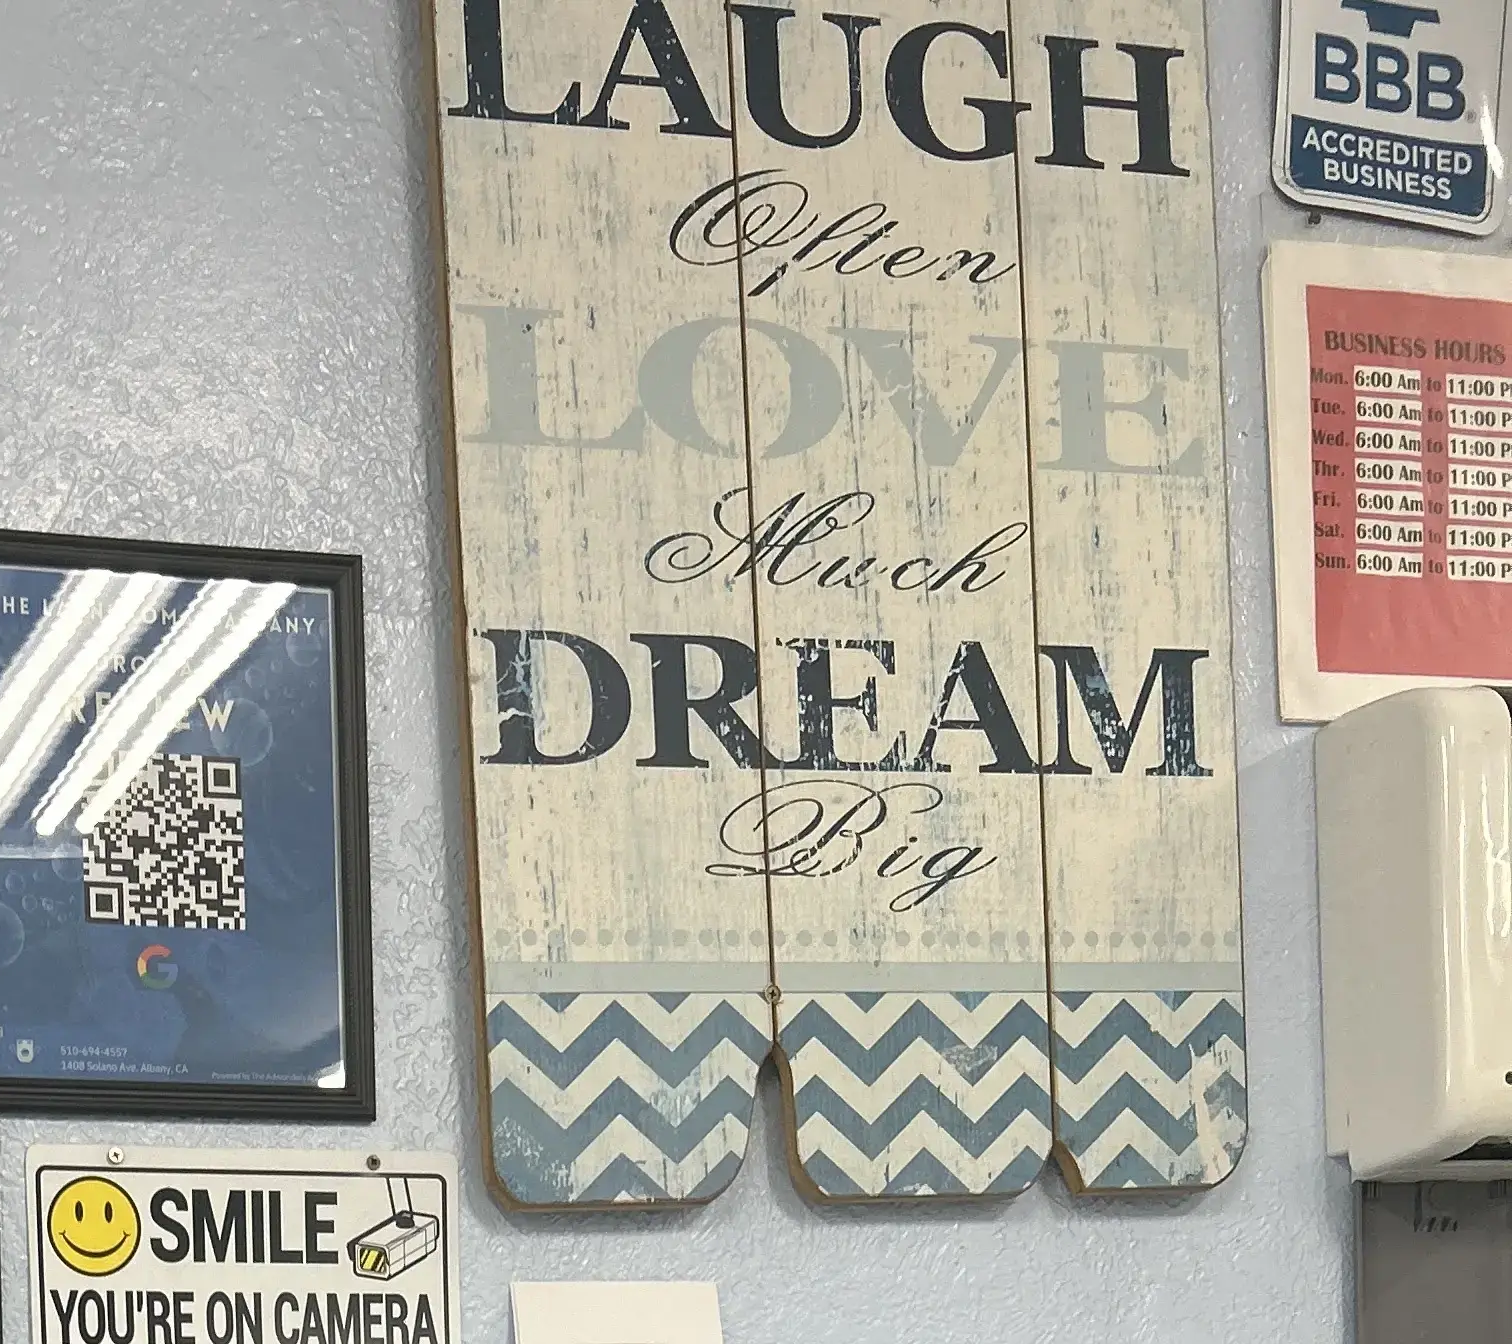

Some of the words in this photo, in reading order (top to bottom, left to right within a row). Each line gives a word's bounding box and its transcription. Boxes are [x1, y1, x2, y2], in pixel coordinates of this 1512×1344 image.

[447, 0, 1193, 178] LAUGH
[1314, 32, 1466, 121] BBB
[1302, 127, 1473, 176] ACCREDITED
[1323, 158, 1452, 200] BUSINESS
[669, 168, 1018, 297] Often
[1325, 330, 1426, 358] BUSINESS
[1435, 339, 1506, 365] HOURS
[455, 302, 1209, 479] LOVE
[1310, 367, 1348, 385] Mon.
[1355, 370, 1393, 388] 6:00
[1398, 374, 1420, 390] Am
[1427, 377, 1441, 391] to
[1448, 378, 1494, 396] 11:00
[1312, 398, 1345, 415] Tue.
[1357, 401, 1393, 419] 6:00
[1399, 405, 1421, 421] Am
[1428, 408, 1443, 422] to
[1450, 409, 1495, 427] 11:00
[1312, 429, 1349, 446] Wed.
[1356, 431, 1393, 449] 6:00
[1399, 435, 1421, 451] Am
[1427, 439, 1443, 452] to
[1450, 438, 1495, 456] 11:00
[1313, 460, 1344, 477] Thr.
[1356, 462, 1393, 480] 6:00
[1399, 465, 1422, 481] Am
[1427, 469, 1443, 484] to
[1451, 469, 1496, 486] 11:00
[1314, 491, 1341, 507] Fri.
[1357, 493, 1394, 511] 6:00
[1399, 496, 1423, 512] Am
[1428, 501, 1443, 514] to
[1451, 499, 1497, 517] 11:00
[644, 487, 1028, 593] Much
[1314, 522, 1344, 538] Sat.
[1357, 523, 1392, 541] 6:00
[1397, 527, 1422, 543] Am
[1428, 530, 1442, 544] to
[1449, 530, 1495, 548] 11:00
[1315, 553, 1350, 568] Sun.
[1357, 554, 1392, 572] 6:00
[1398, 557, 1421, 573] Am
[1428, 560, 1443, 574] to
[1449, 560, 1495, 577] 11:00
[473, 628, 1213, 777] DREAM
[705, 779, 999, 914] Big
[60, 1046, 128, 1057] 510-694-4557
[87, 1061, 118, 1072] Solano
[140, 1063, 173, 1075] Albany,
[175, 1064, 188, 1073] CA
[150, 1187, 338, 1264] SMILE
